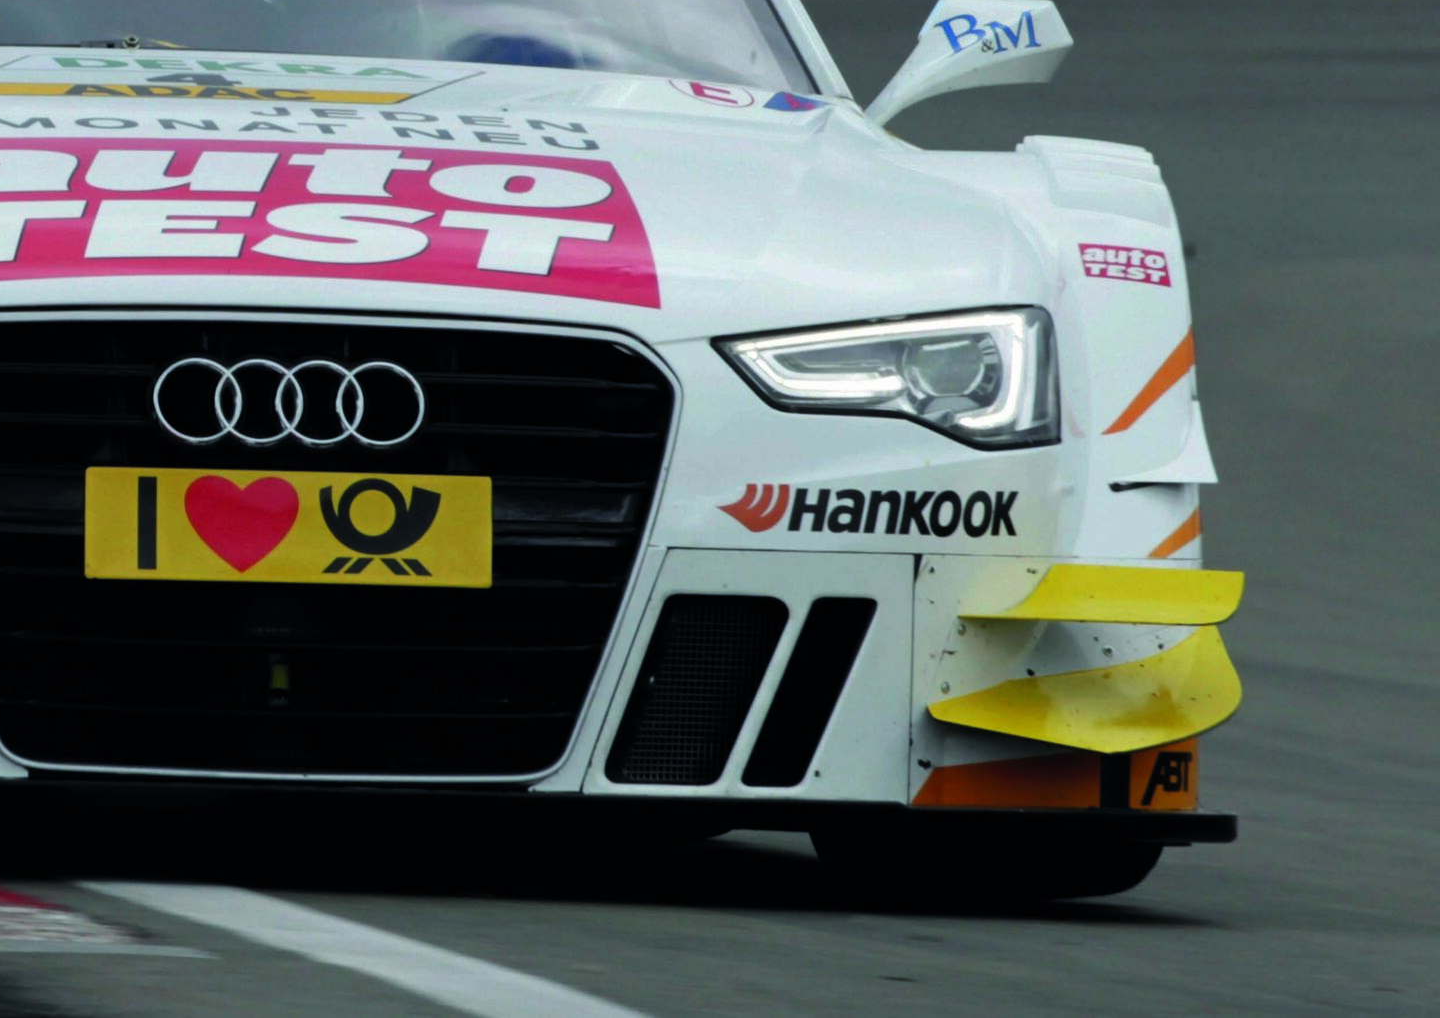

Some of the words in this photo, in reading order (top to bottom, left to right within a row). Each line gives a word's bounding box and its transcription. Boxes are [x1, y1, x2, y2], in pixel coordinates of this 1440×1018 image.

[933, 10, 1042, 57] B&M
[52, 57, 432, 80] DEKRA
[146, 73, 243, 86] 4
[64, 84, 315, 101] ADAC
[250, 106, 589, 135] JEDEN
[392, 126, 601, 151] NEU
[1082, 247, 1167, 270] auto
[1084, 262, 1168, 283] TEST
[137, 475, 158, 571] I
[1141, 751, 1193, 807] ABT
